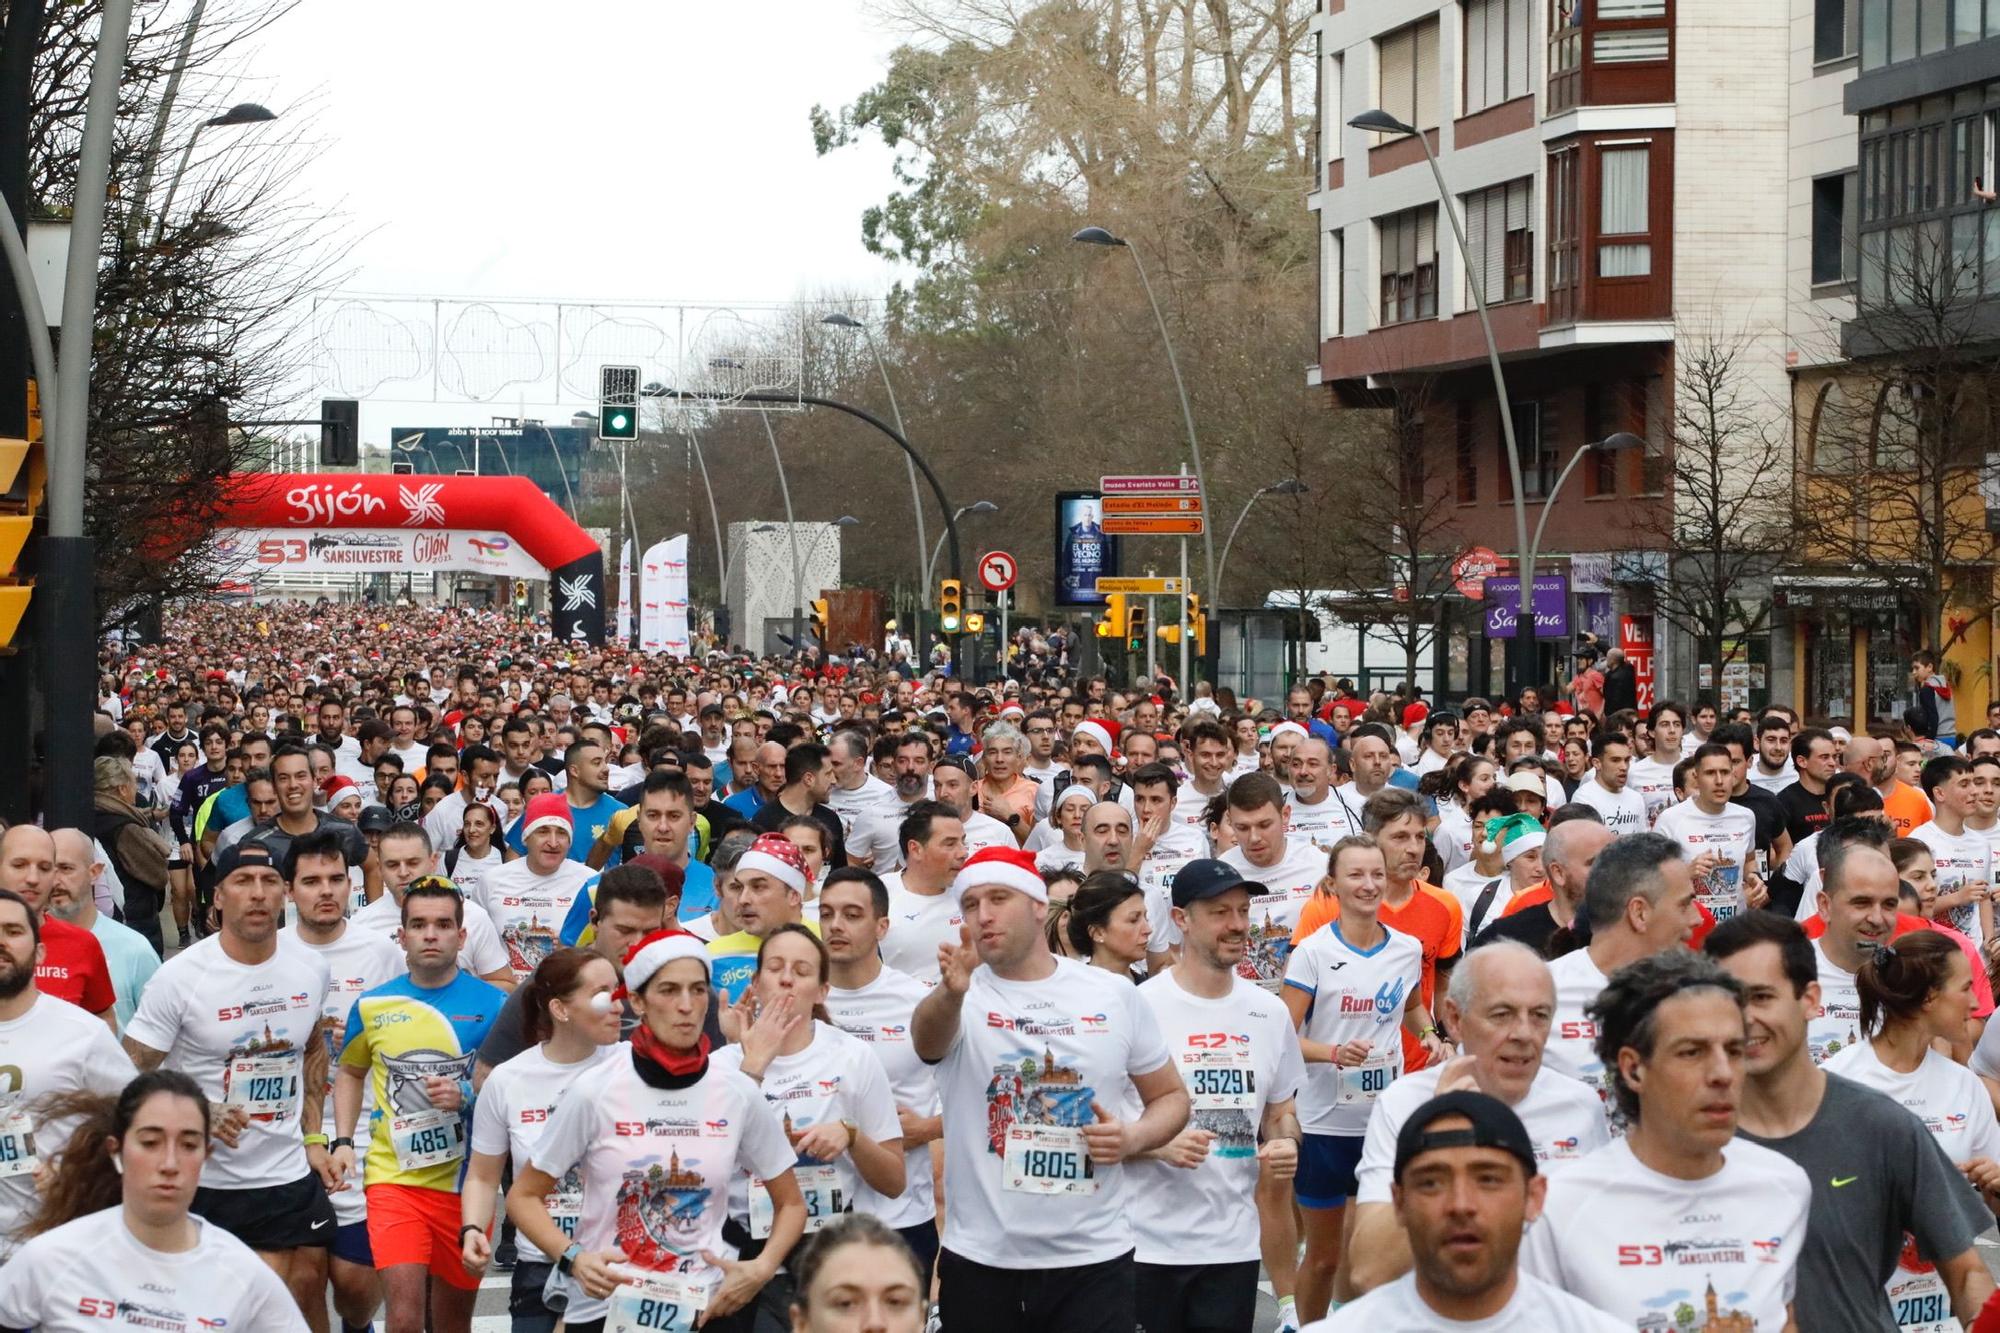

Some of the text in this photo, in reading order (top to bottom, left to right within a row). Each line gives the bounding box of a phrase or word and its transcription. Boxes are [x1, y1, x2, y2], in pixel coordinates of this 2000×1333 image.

[286, 483, 386, 525] gijón
[257, 539, 403, 564] 53 SANSILVESTRE
[1072, 543, 1101, 551] EL PEOR
[1073, 550, 1101, 558] VECINO
[197, 784, 210, 797] 37
[503, 897, 519, 907] 53
[1340, 996, 1394, 1013] Run 04
[218, 1006, 243, 1022] 53
[1561, 1022, 1597, 1039] 53
[1188, 1033, 1227, 1048] 52
[1183, 1053, 1201, 1063] 53
[235, 1063, 254, 1072] 53
[249, 1077, 283, 1101] 1213
[1194, 1069, 1243, 1095] 3529
[1362, 1069, 1383, 1092] 80
[521, 1109, 546, 1123] 53
[615, 1121, 645, 1136] 53
[654, 1128, 700, 1137] SANSILVESTRE
[1011, 1129, 1032, 1140] 53
[411, 1127, 448, 1155] 485
[1024, 1149, 1077, 1180] 1805
[1618, 1245, 1746, 1266] 53 SANSILVESTRE
[77, 1297, 187, 1333] 53 SANSILVESTRE
[637, 1298, 679, 1332] 812
[1898, 1293, 1943, 1327] 2031
